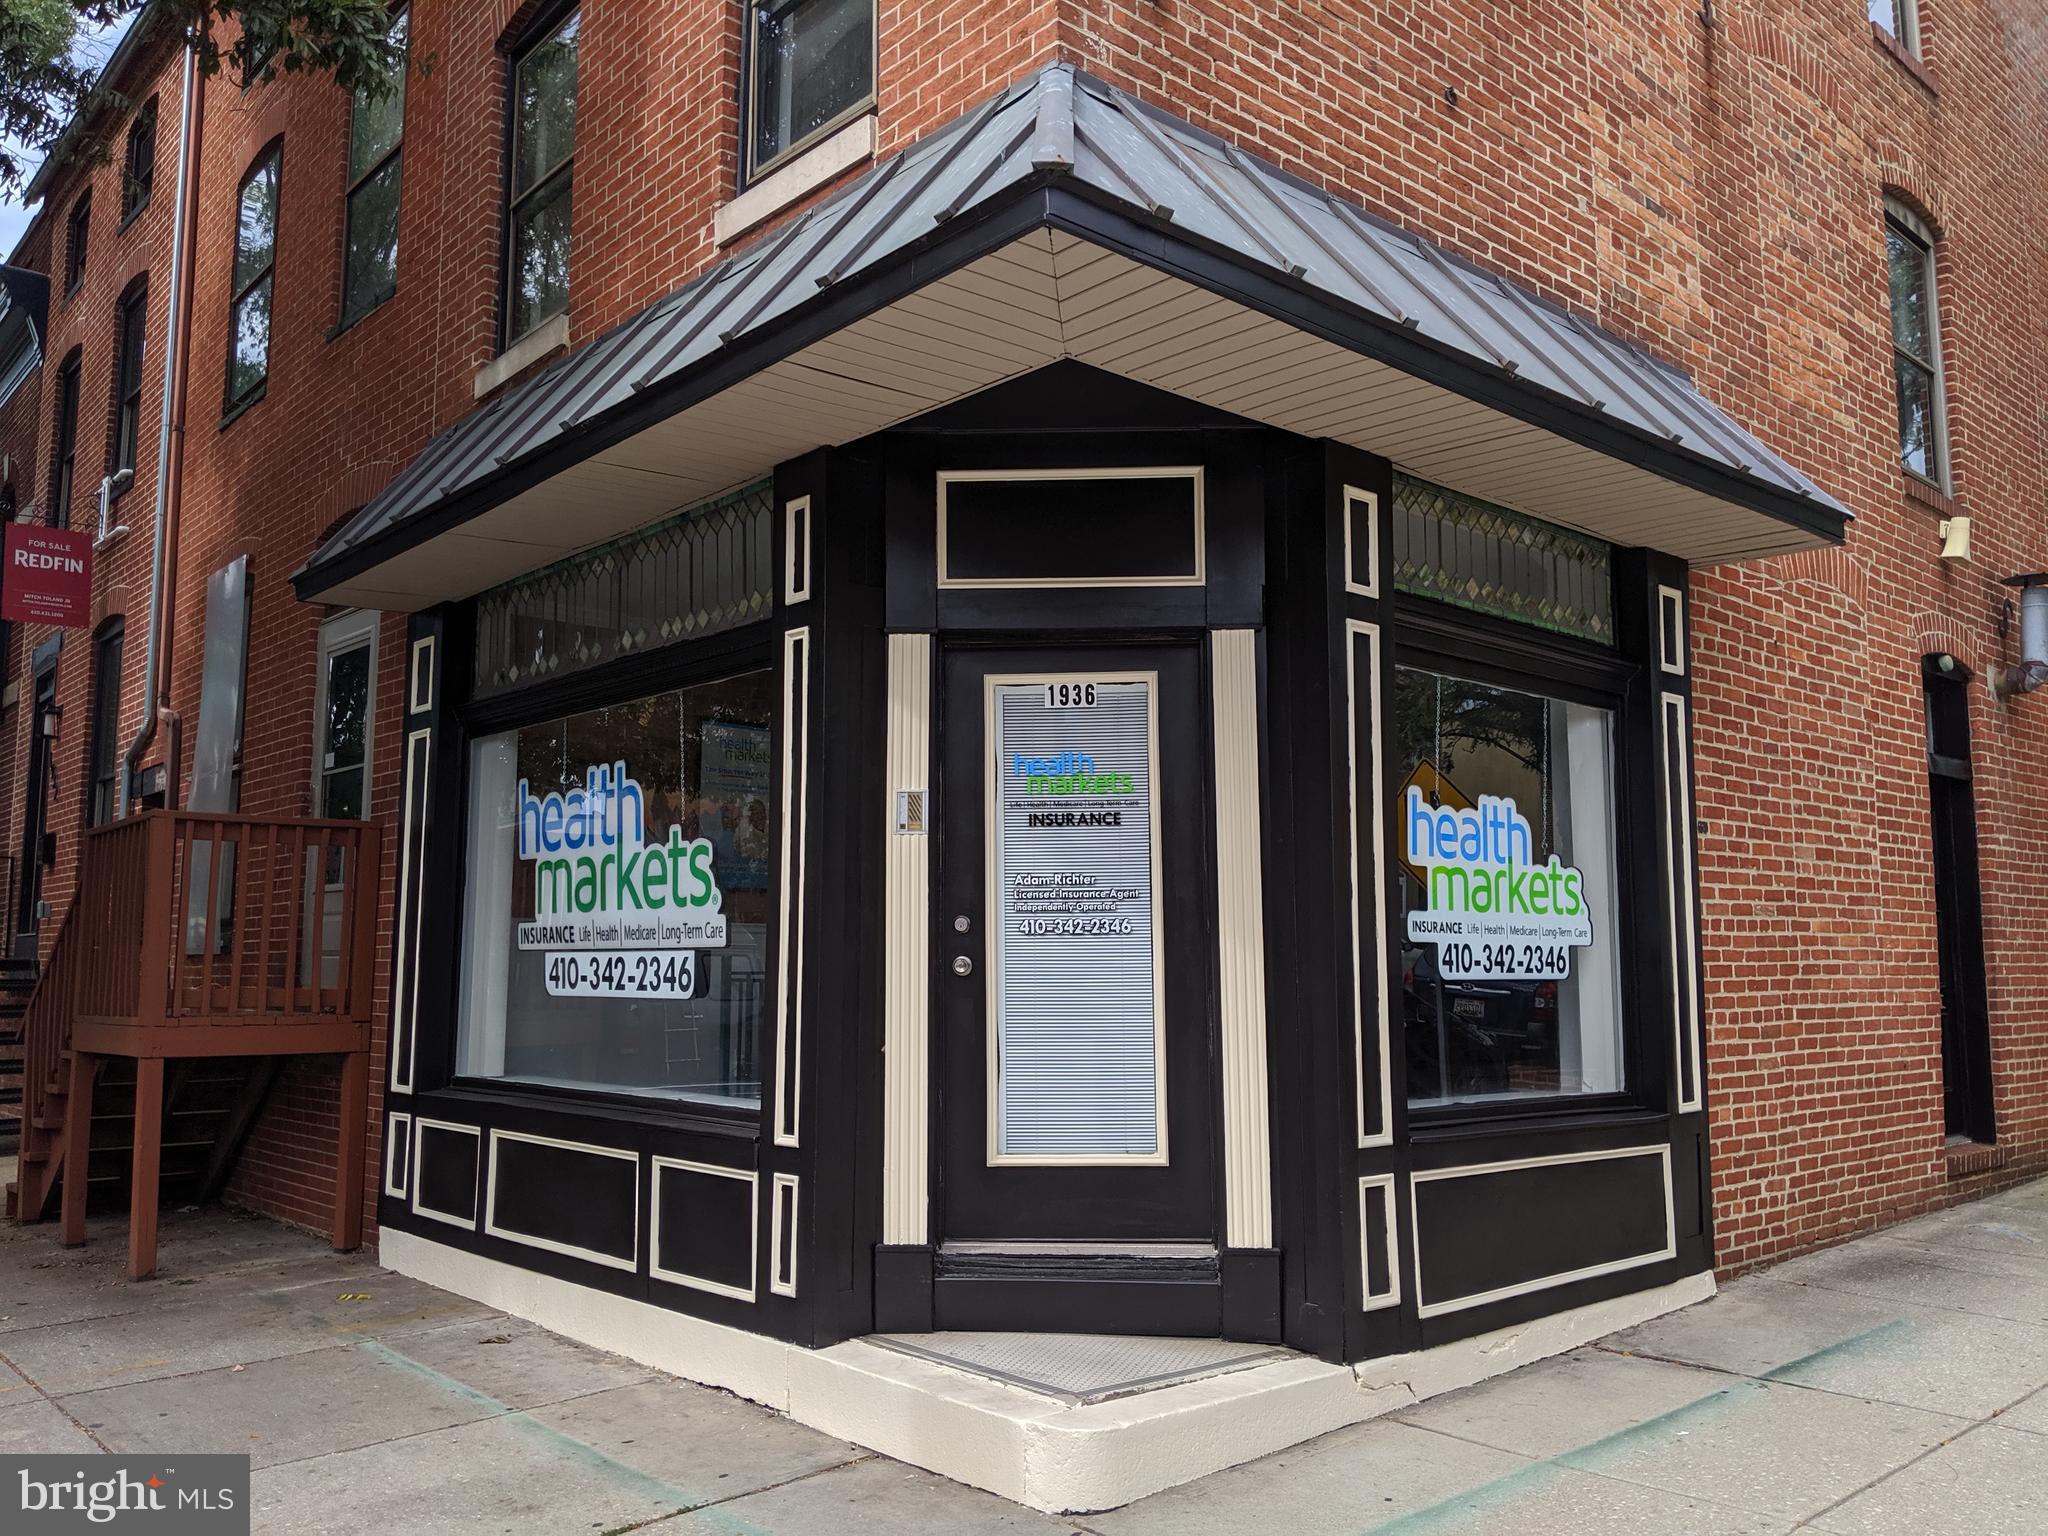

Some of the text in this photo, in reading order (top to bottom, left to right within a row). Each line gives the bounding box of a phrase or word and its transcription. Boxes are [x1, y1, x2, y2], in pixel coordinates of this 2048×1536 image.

[28, 539, 72, 552] FOR SALE
[14, 549, 84, 574] REDFIN
[1048, 684, 1096, 706] 1936
[1014, 752, 1095, 777] health
[1026, 771, 1136, 796] markets
[521, 766, 642, 855] health
[1028, 812, 1121, 827] INSURANCE
[1411, 794, 1528, 865] health
[1014, 874, 1096, 885] Adam Richter
[1432, 856, 1581, 916] markets
[1014, 888, 1139, 900] Licensed Insurance Agent
[1014, 902, 1116, 912] Independently Operated
[520, 922, 724, 945] INSURANCE Life Health Medicare Long-Term Care
[1020, 918, 1132, 934] 410-342-2346
[1412, 921, 1588, 939] INSURANCE Life Health Medicare Long-Term Care
[1442, 943, 1566, 974] 410-342-2346
[549, 956, 692, 992] 410-342-2346
